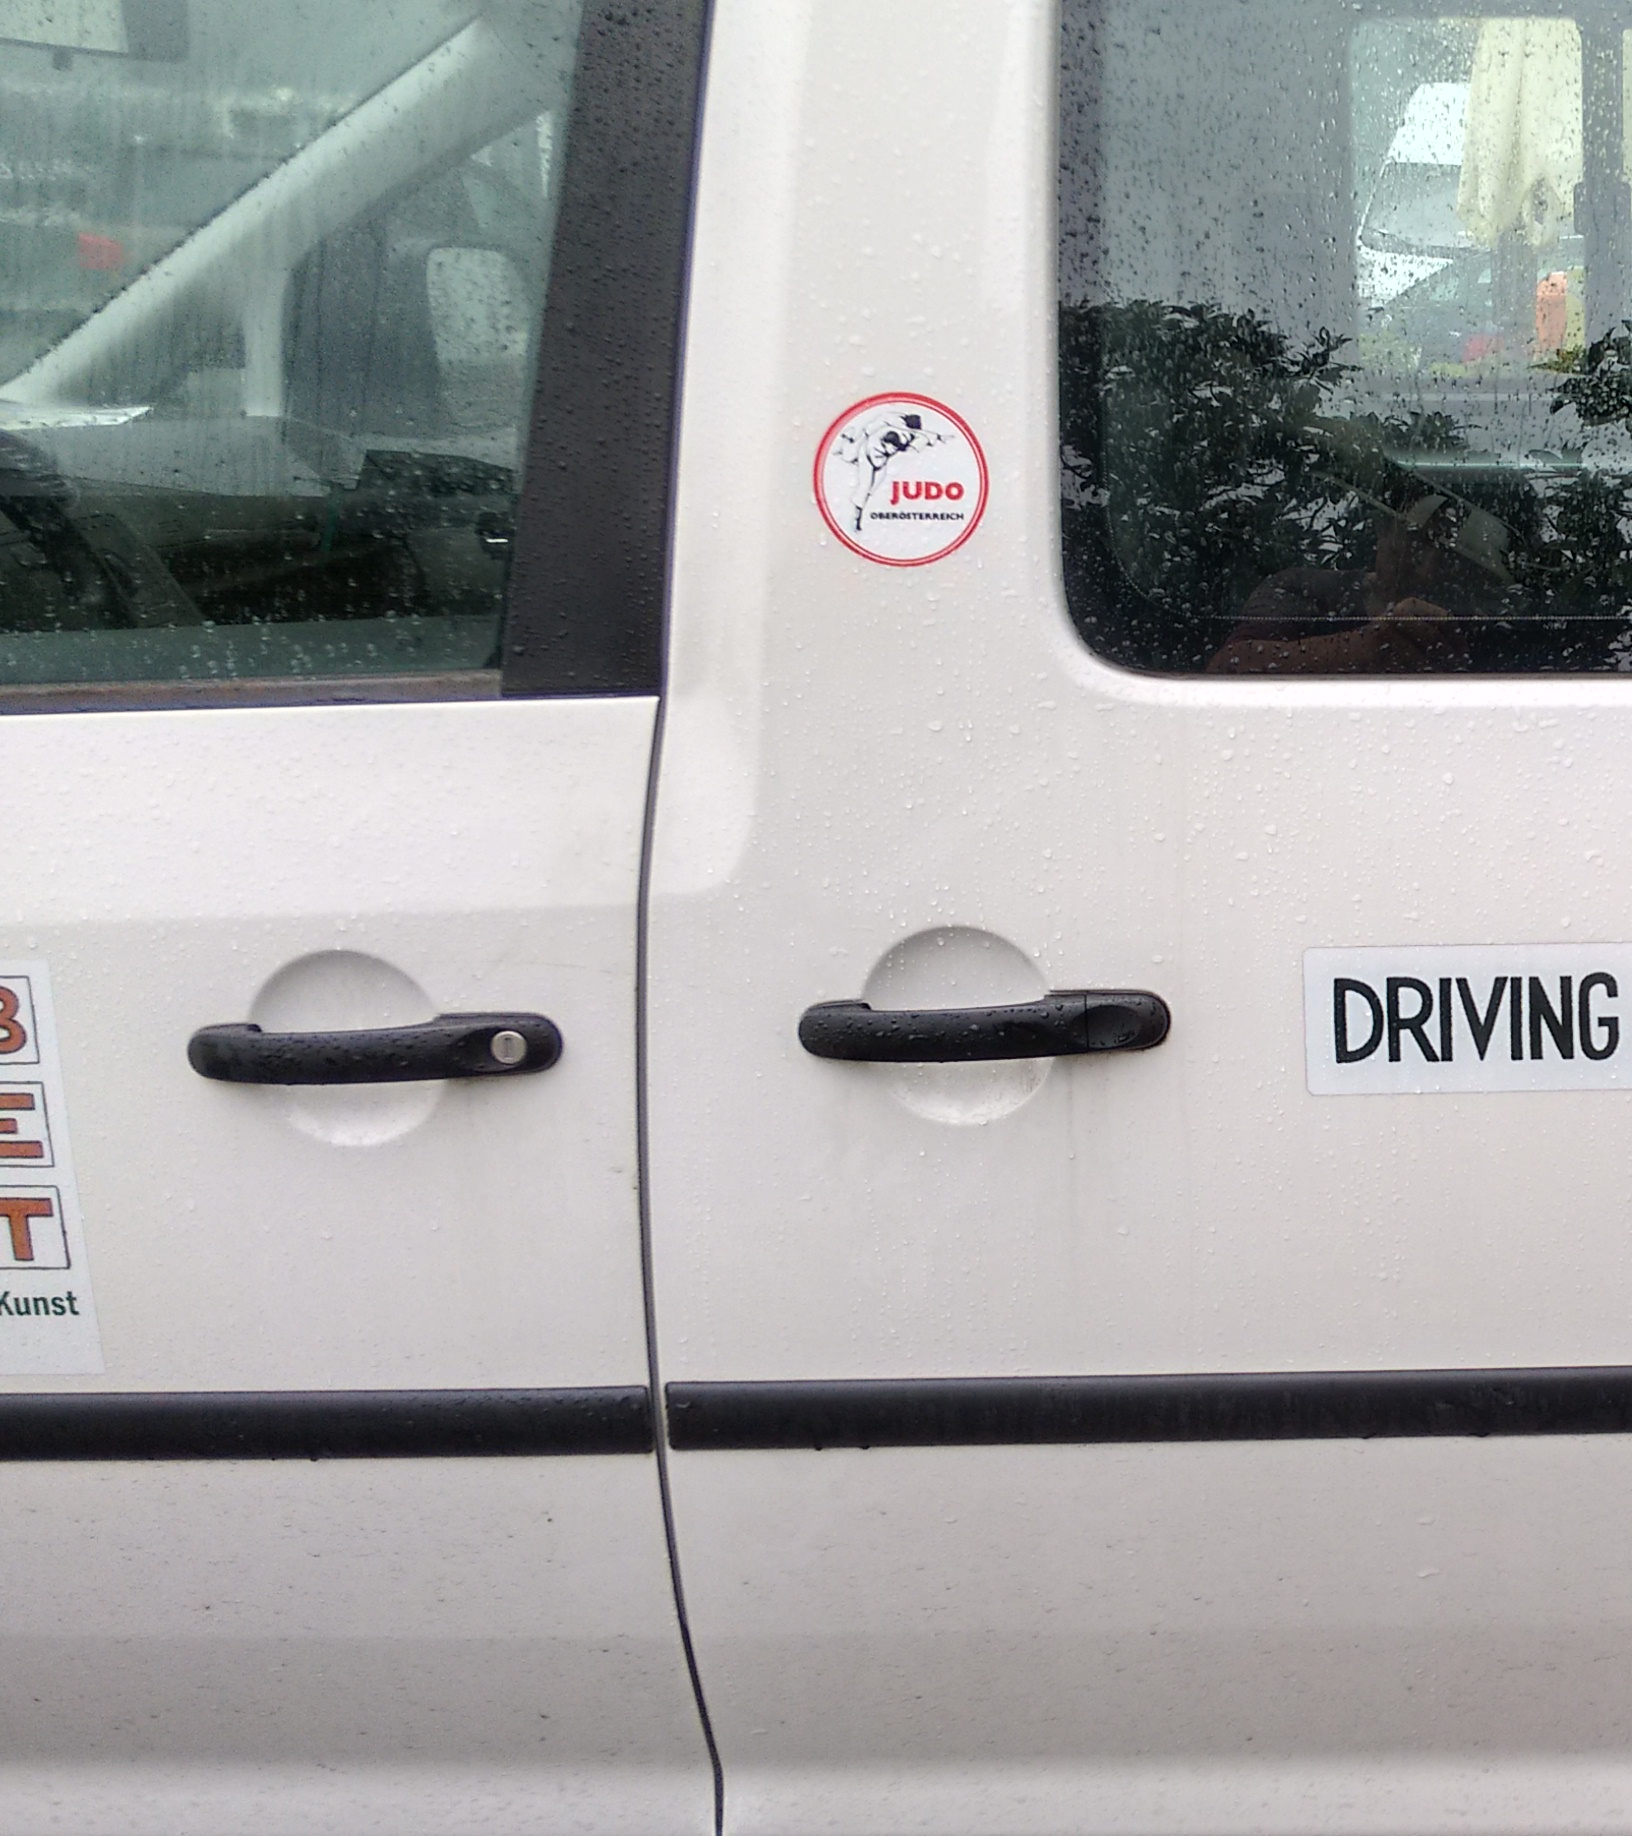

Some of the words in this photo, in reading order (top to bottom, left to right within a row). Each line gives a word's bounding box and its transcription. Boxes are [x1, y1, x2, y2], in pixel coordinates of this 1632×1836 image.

[890, 481, 964, 505] JUDO
[1333, 972, 1619, 1064] DRIVING
[0, 1291, 80, 1316] Kunst
